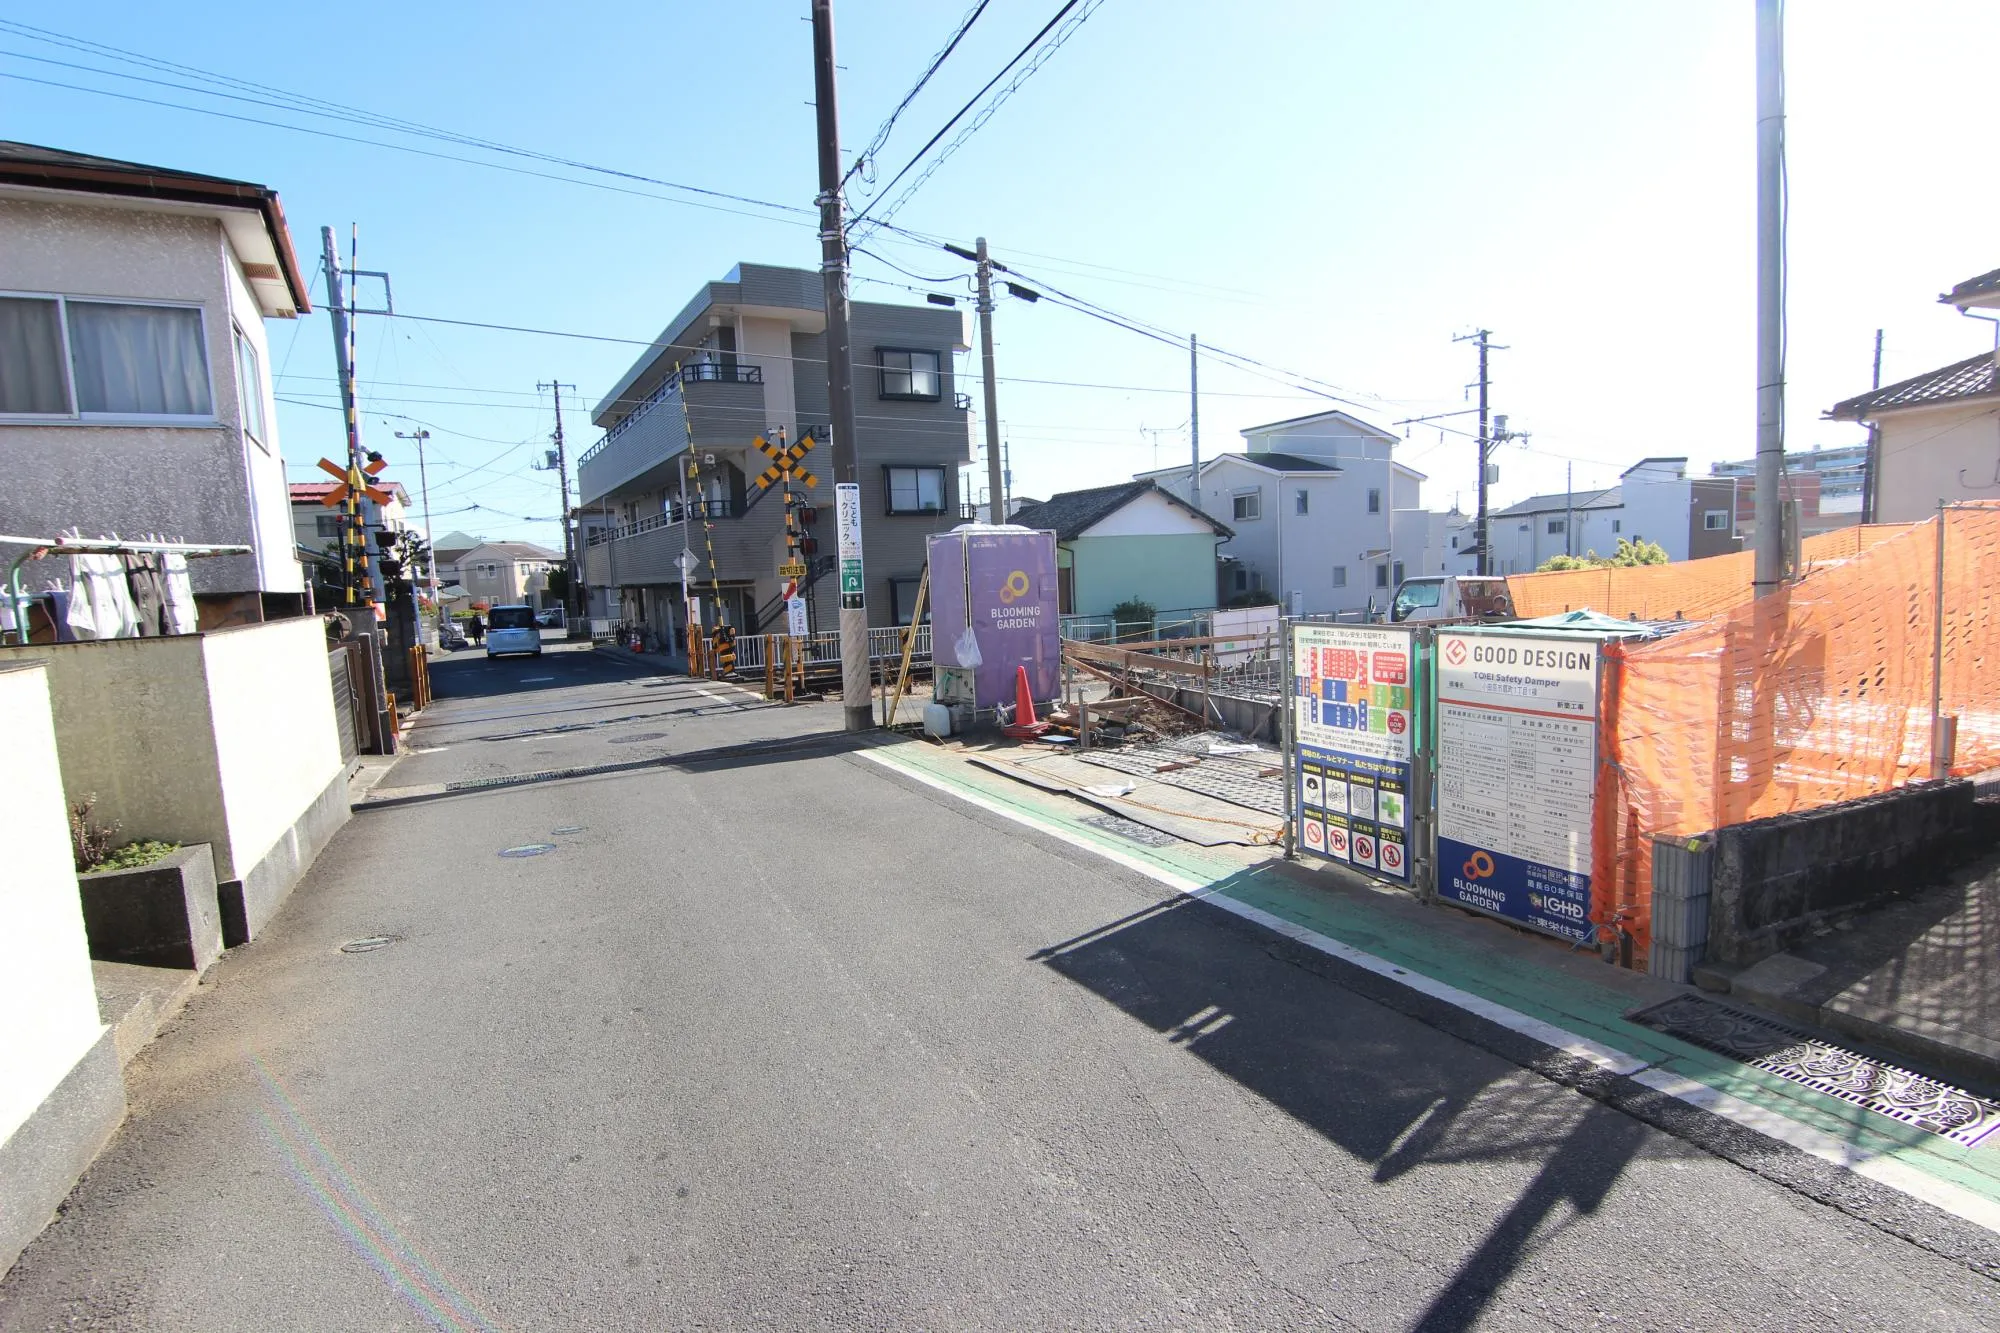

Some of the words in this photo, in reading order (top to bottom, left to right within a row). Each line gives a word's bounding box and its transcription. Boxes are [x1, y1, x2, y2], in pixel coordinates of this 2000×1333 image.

[779, 565, 806, 575] 踏切注意
[991, 606, 1041, 618] BLOOMING
[797, 611, 805, 632] とまれ
[997, 618, 1036, 630] GARDEN
[1474, 646, 1517, 664] GOOD
[1523, 649, 1591, 670] DESIGN
[1495, 673, 1523, 685] Safety
[1525, 676, 1560, 688] Damper
[1557, 701, 1584, 711] 新築工事
[1355, 759, 1404, 776] 私たちは守ります
[1381, 833, 1402, 843] 立入禁止
[1453, 878, 1506, 902] BLOOMING
[1459, 892, 1500, 912] GARDEN
[1536, 917, 1584, 940] 東栄住宅
